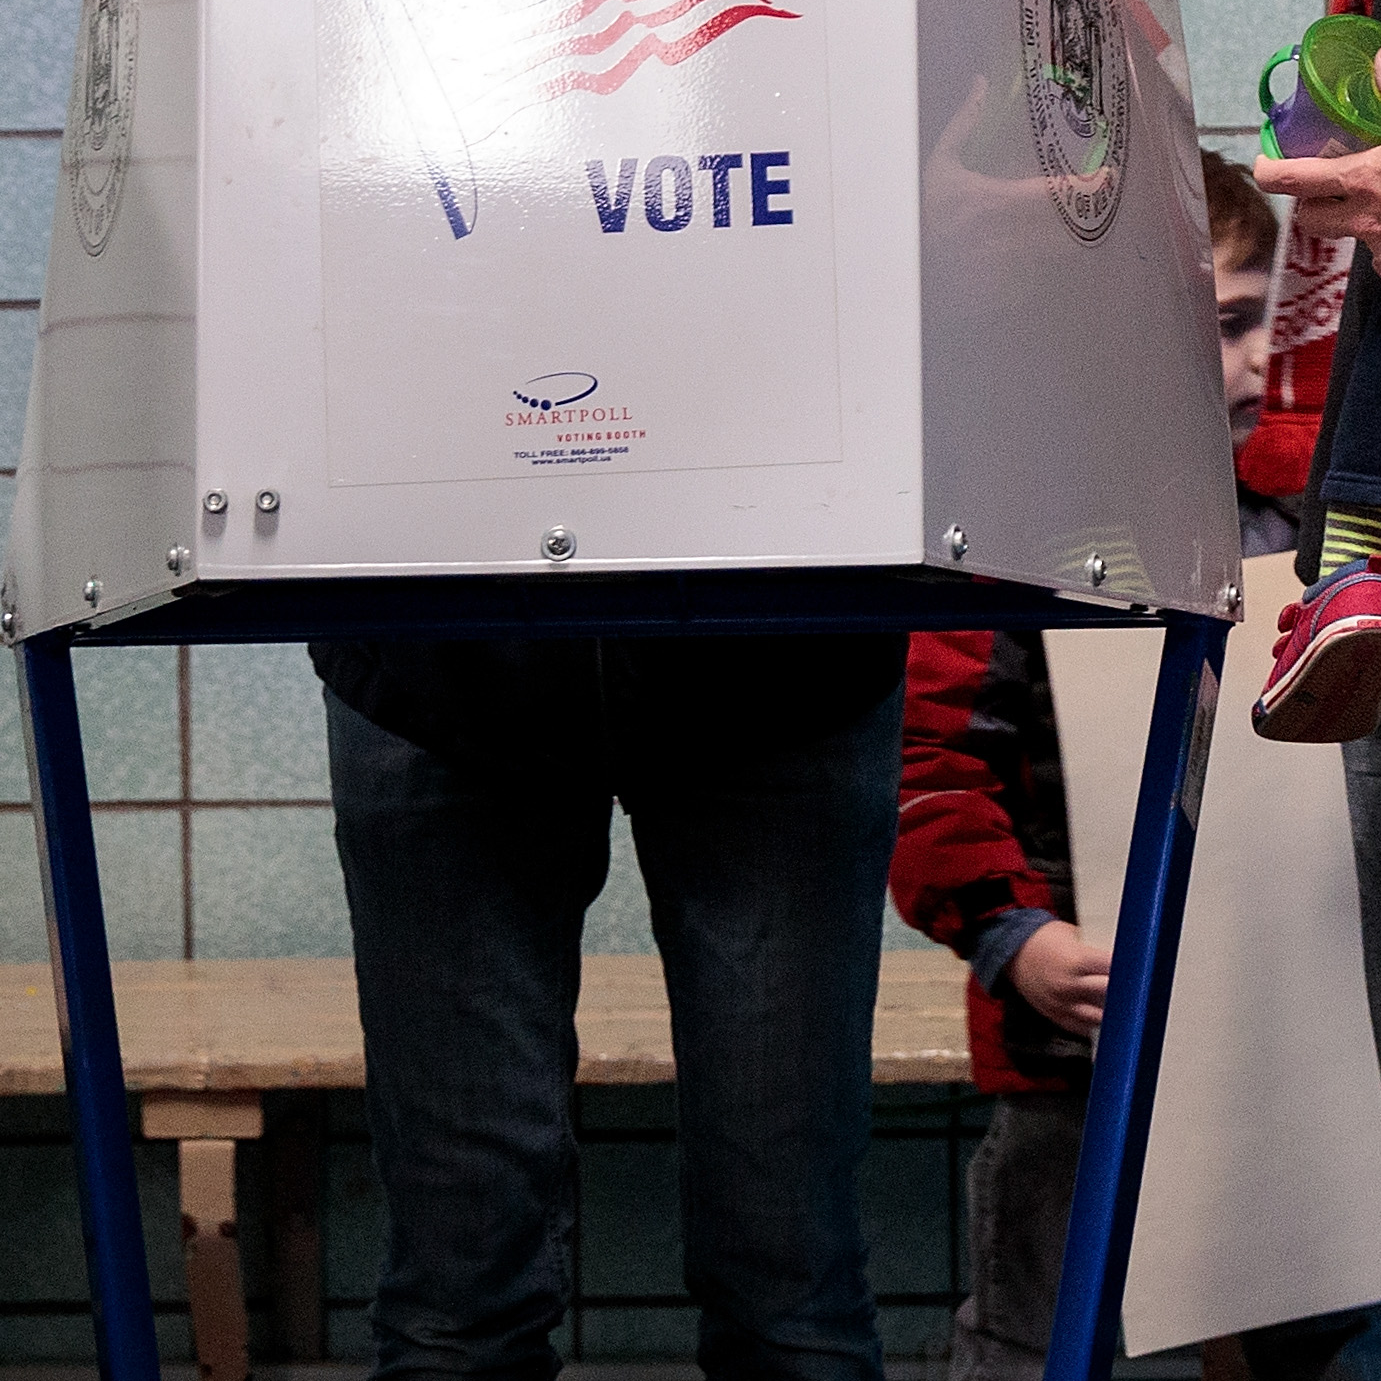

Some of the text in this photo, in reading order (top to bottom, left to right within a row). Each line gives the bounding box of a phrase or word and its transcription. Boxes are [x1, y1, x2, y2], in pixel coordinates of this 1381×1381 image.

[585, 151, 793, 233] VOTE
[505, 406, 633, 427] SMARTPOLL
[557, 430, 647, 443] VOTING BOOTH
[514, 451, 538, 459] TOLL
[540, 449, 568, 458] FREE:
